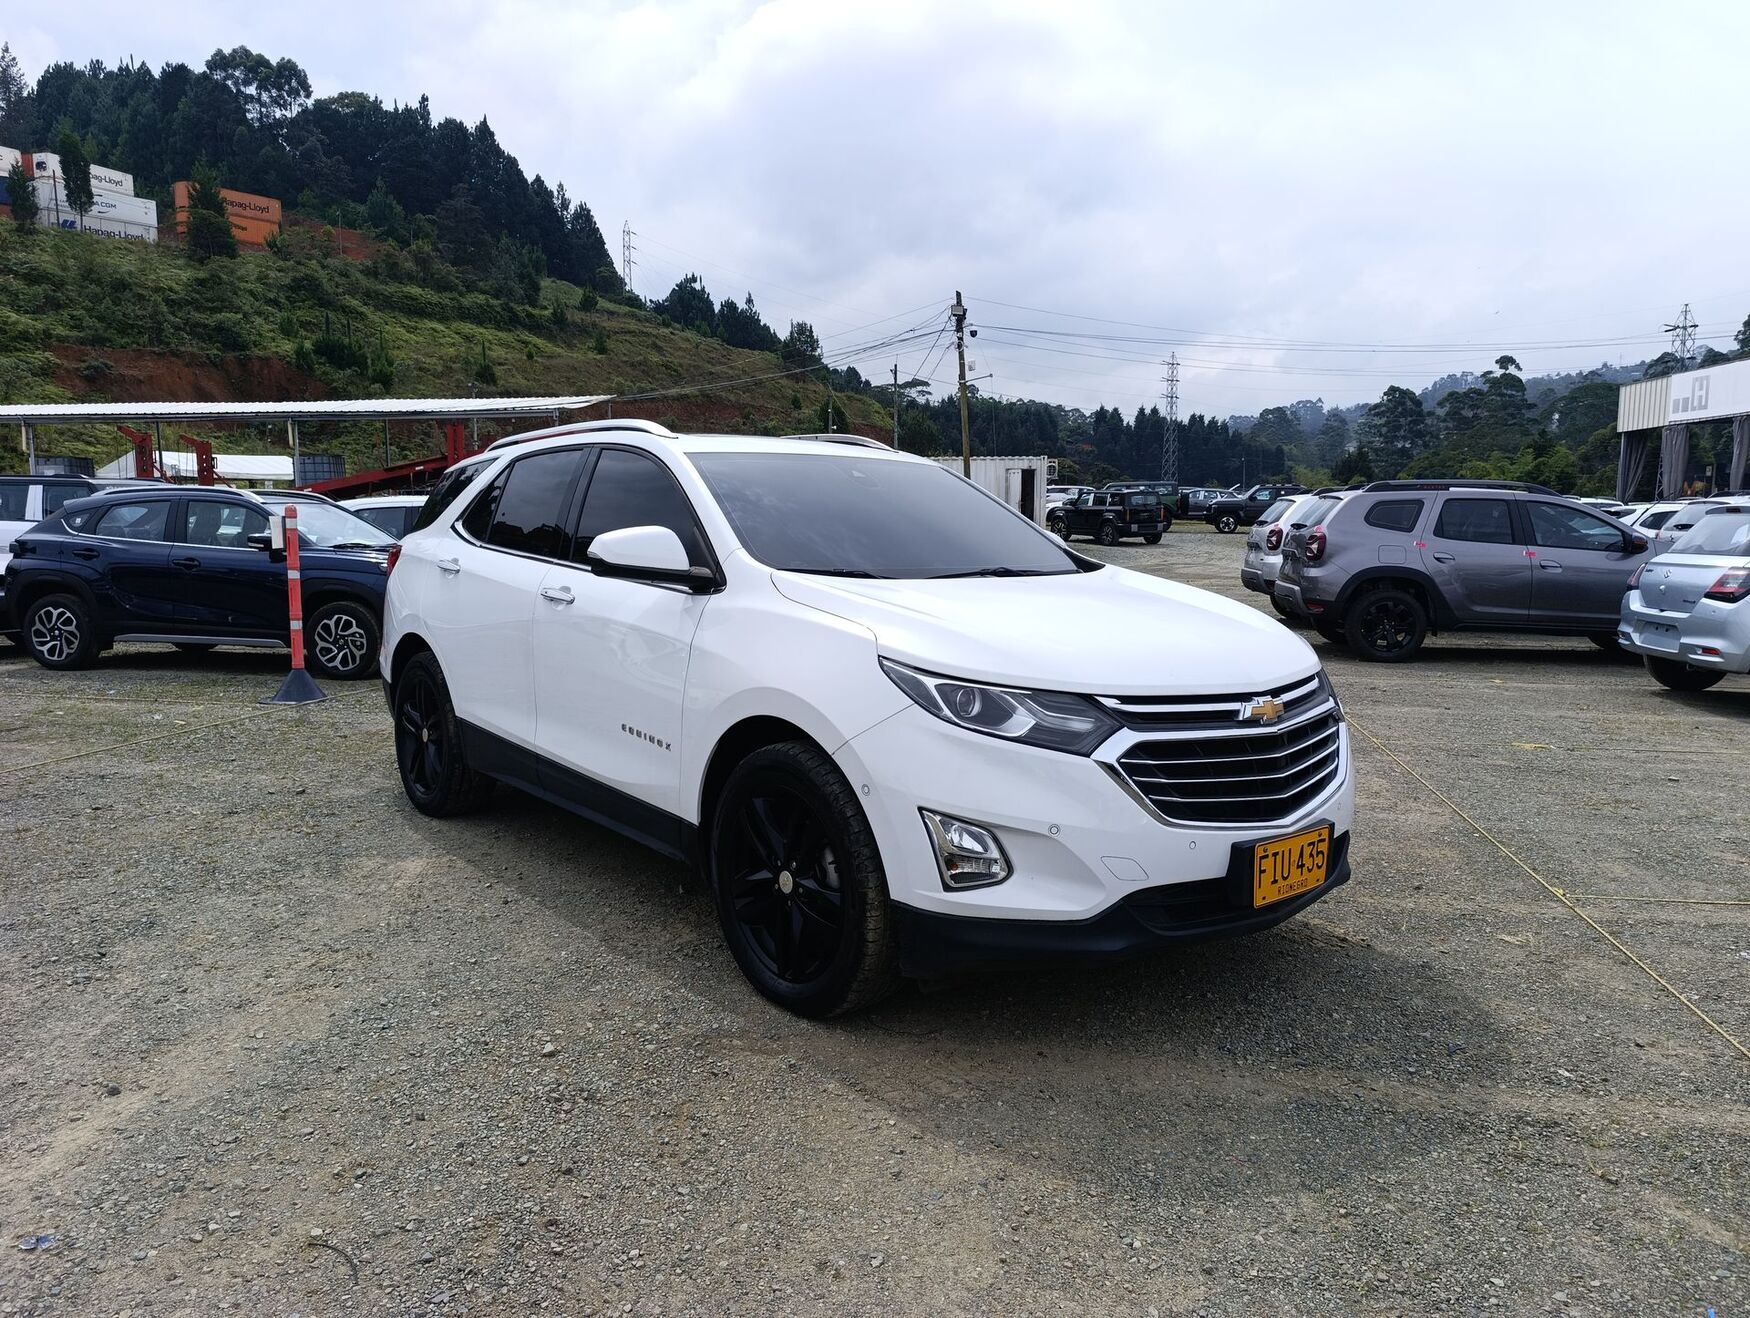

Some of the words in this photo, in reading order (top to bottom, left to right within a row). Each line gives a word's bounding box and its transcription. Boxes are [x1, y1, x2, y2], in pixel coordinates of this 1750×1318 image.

[90, 172, 123, 187] pag-Lloyd
[101, 201, 117, 209] CGM
[224, 198, 270, 214] apag-Lloyd
[621, 723, 672, 752] EQUINOX
[1258, 847, 1292, 889] FIU
[1296, 838, 1327, 876] 435
[1278, 877, 1308, 896] RIONEGRO
